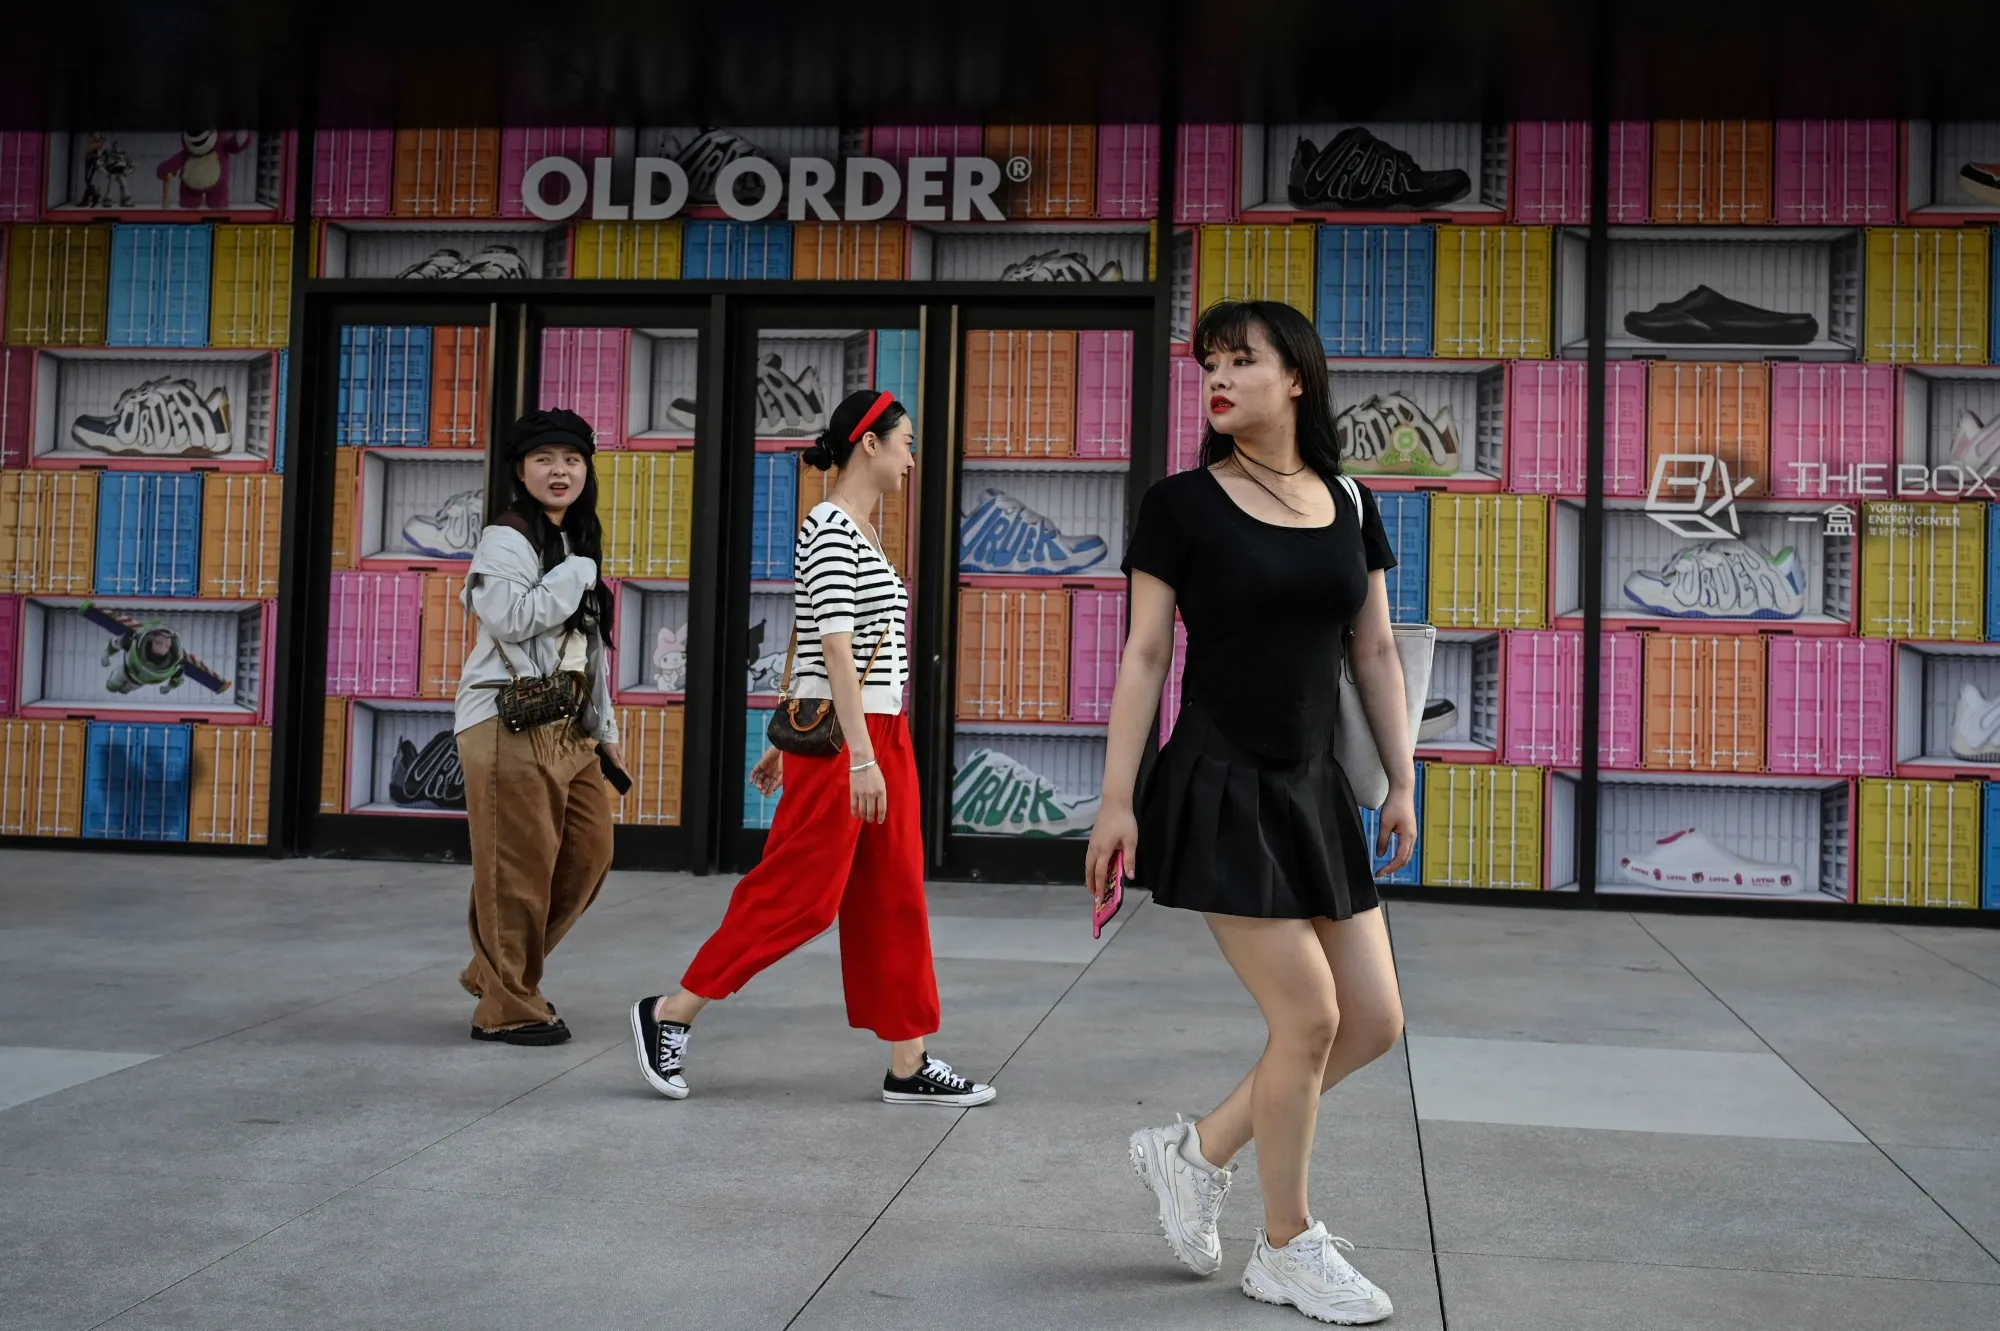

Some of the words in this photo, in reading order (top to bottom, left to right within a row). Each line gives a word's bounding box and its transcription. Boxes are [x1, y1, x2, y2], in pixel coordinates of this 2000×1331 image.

[521, 156, 690, 221] OLD
[1788, 462, 1888, 495] THE
[1896, 464, 1999, 497] BOX
[1869, 504, 1907, 513] YOUTH
[1868, 515, 1914, 525] ENERGY
[1914, 516, 1961, 526] CENTER
